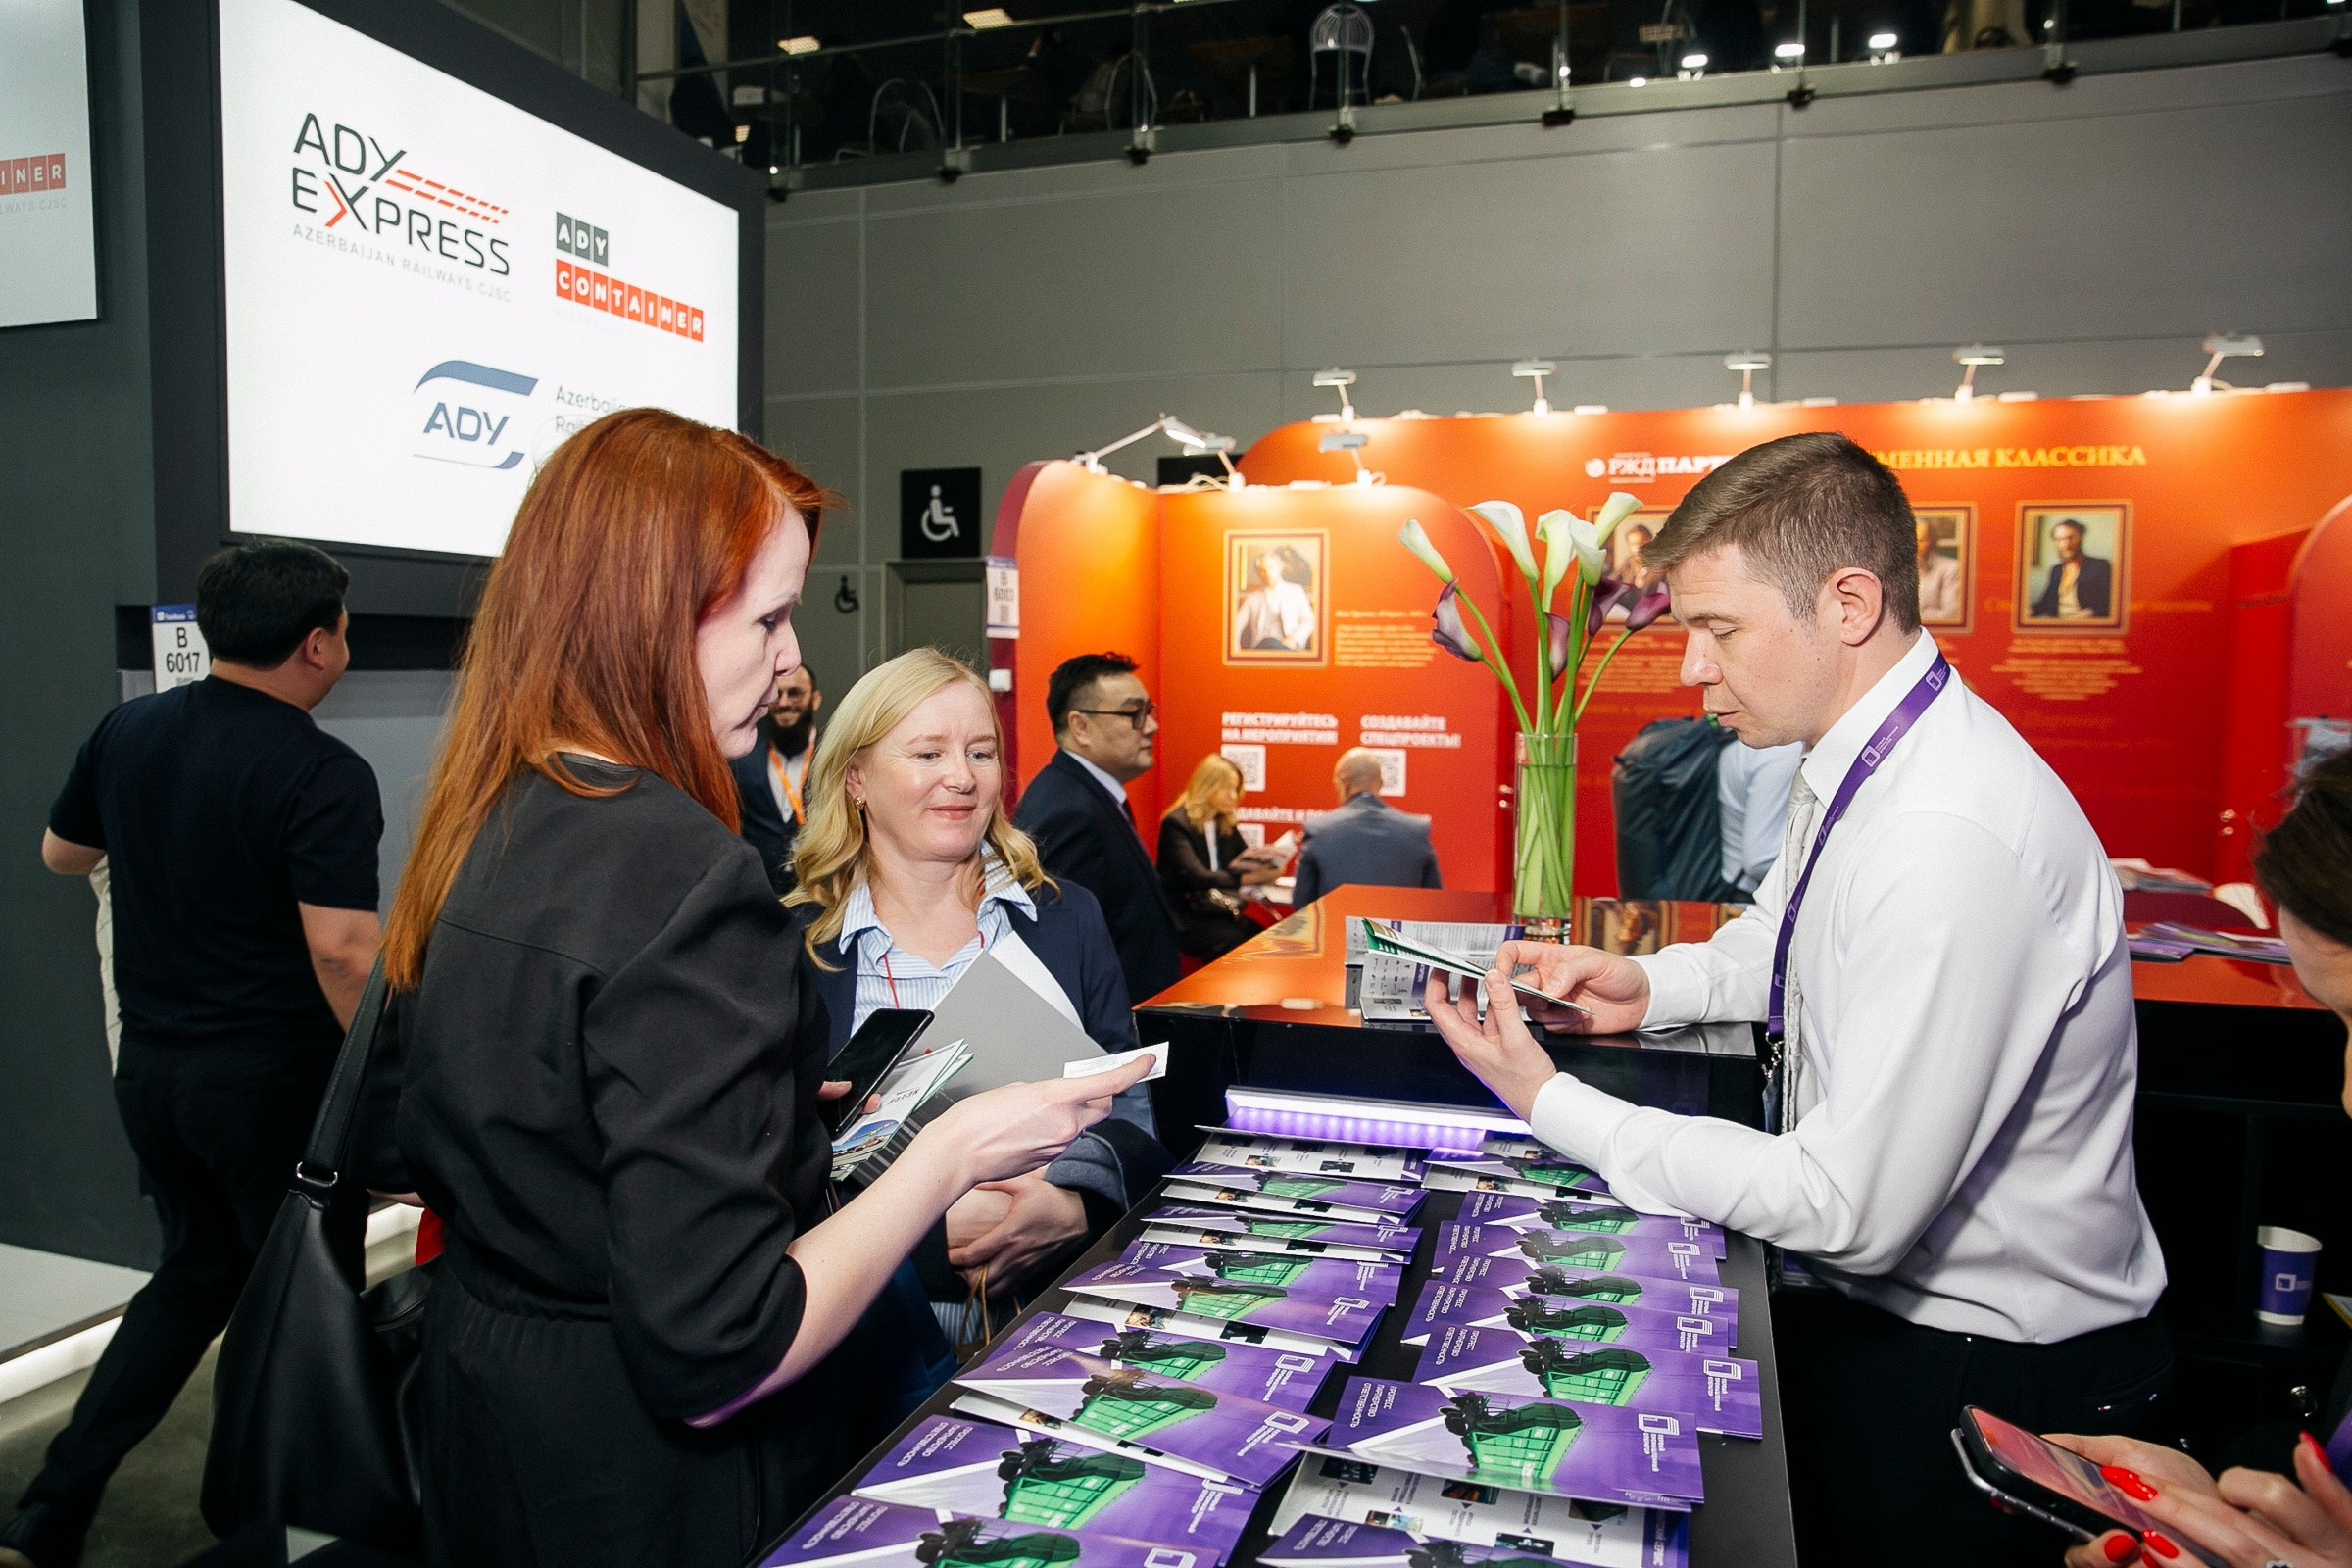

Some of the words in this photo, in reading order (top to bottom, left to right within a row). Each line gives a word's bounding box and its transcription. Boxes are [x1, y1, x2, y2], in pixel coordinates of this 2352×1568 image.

[294, 112, 408, 182] ADY
[292, 167, 510, 276] EXPRESS
[558, 222, 607, 257] ADY
[293, 223, 395, 267] AZERBAIJAN
[402, 257, 473, 291] RAILWAYS
[558, 270, 704, 335] CONTAINER
[423, 402, 519, 445] ADY
[1994, 445, 2146, 468] КЛАССИКА
[177, 627, 188, 648] B
[166, 652, 200, 673] 6017
